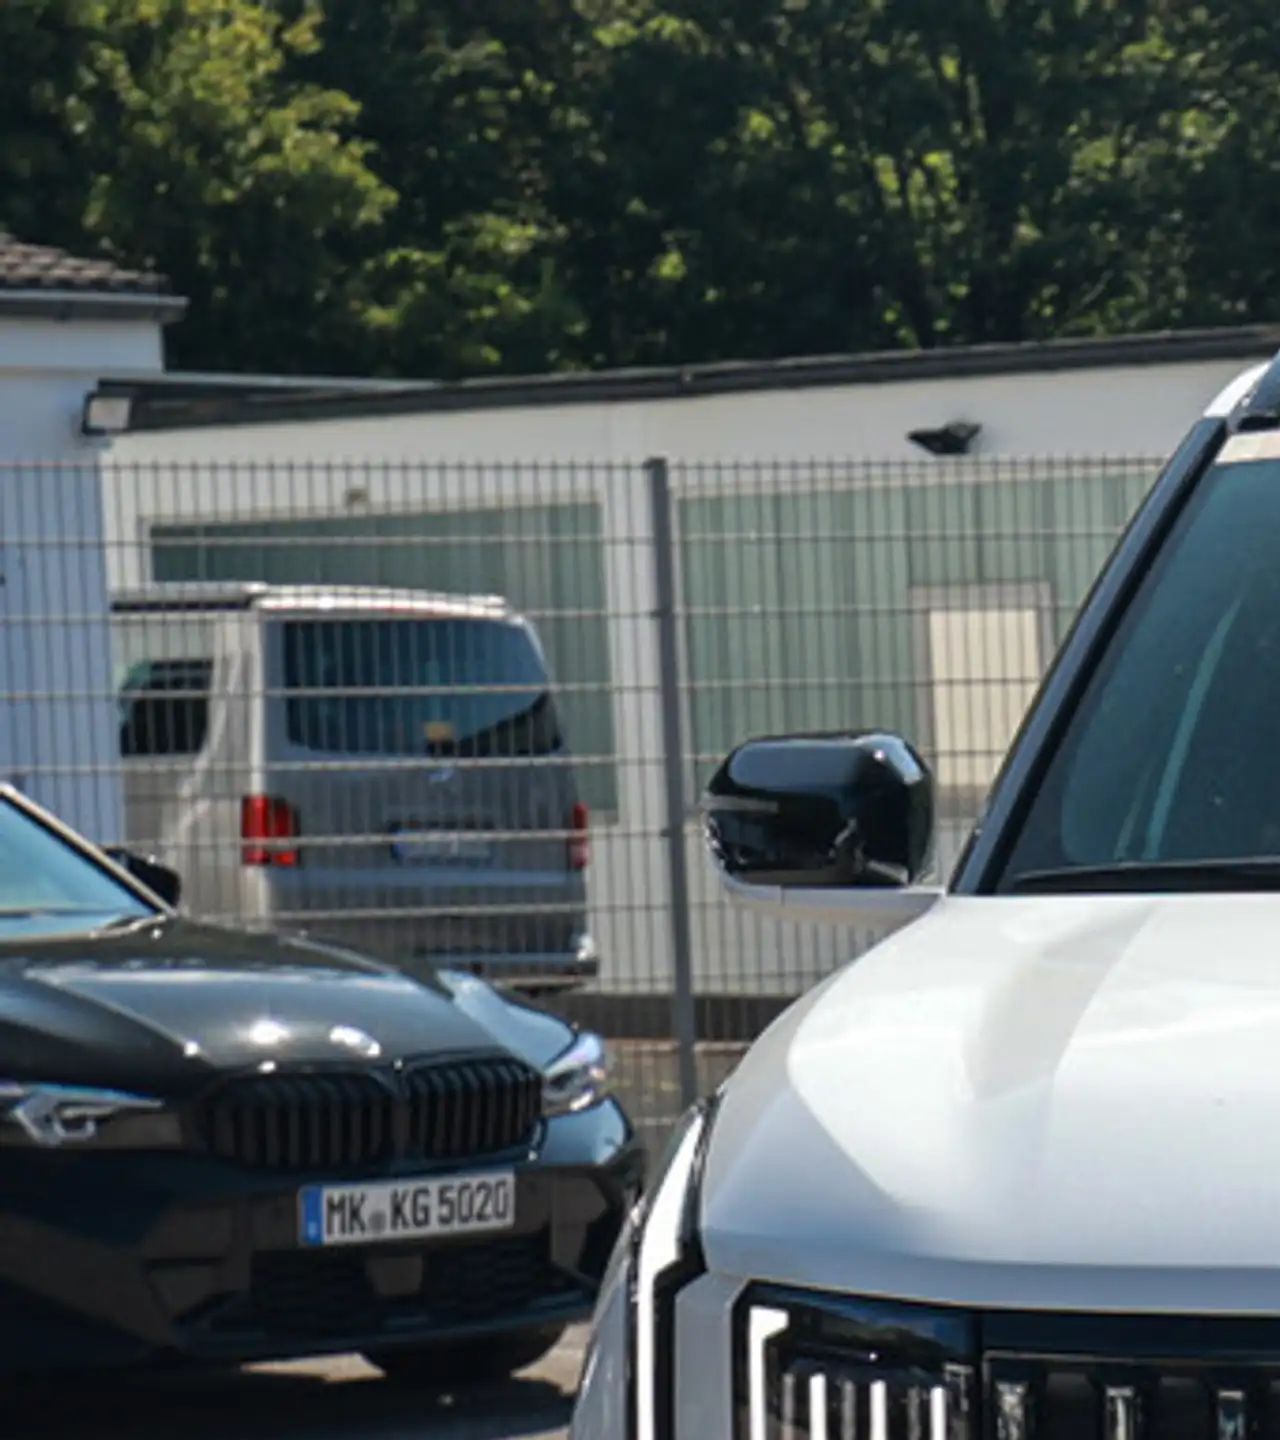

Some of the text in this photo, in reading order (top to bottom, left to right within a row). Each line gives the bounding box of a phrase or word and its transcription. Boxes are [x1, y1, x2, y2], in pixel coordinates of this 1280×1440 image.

[325, 1178, 509, 1236] MK KG 5020
